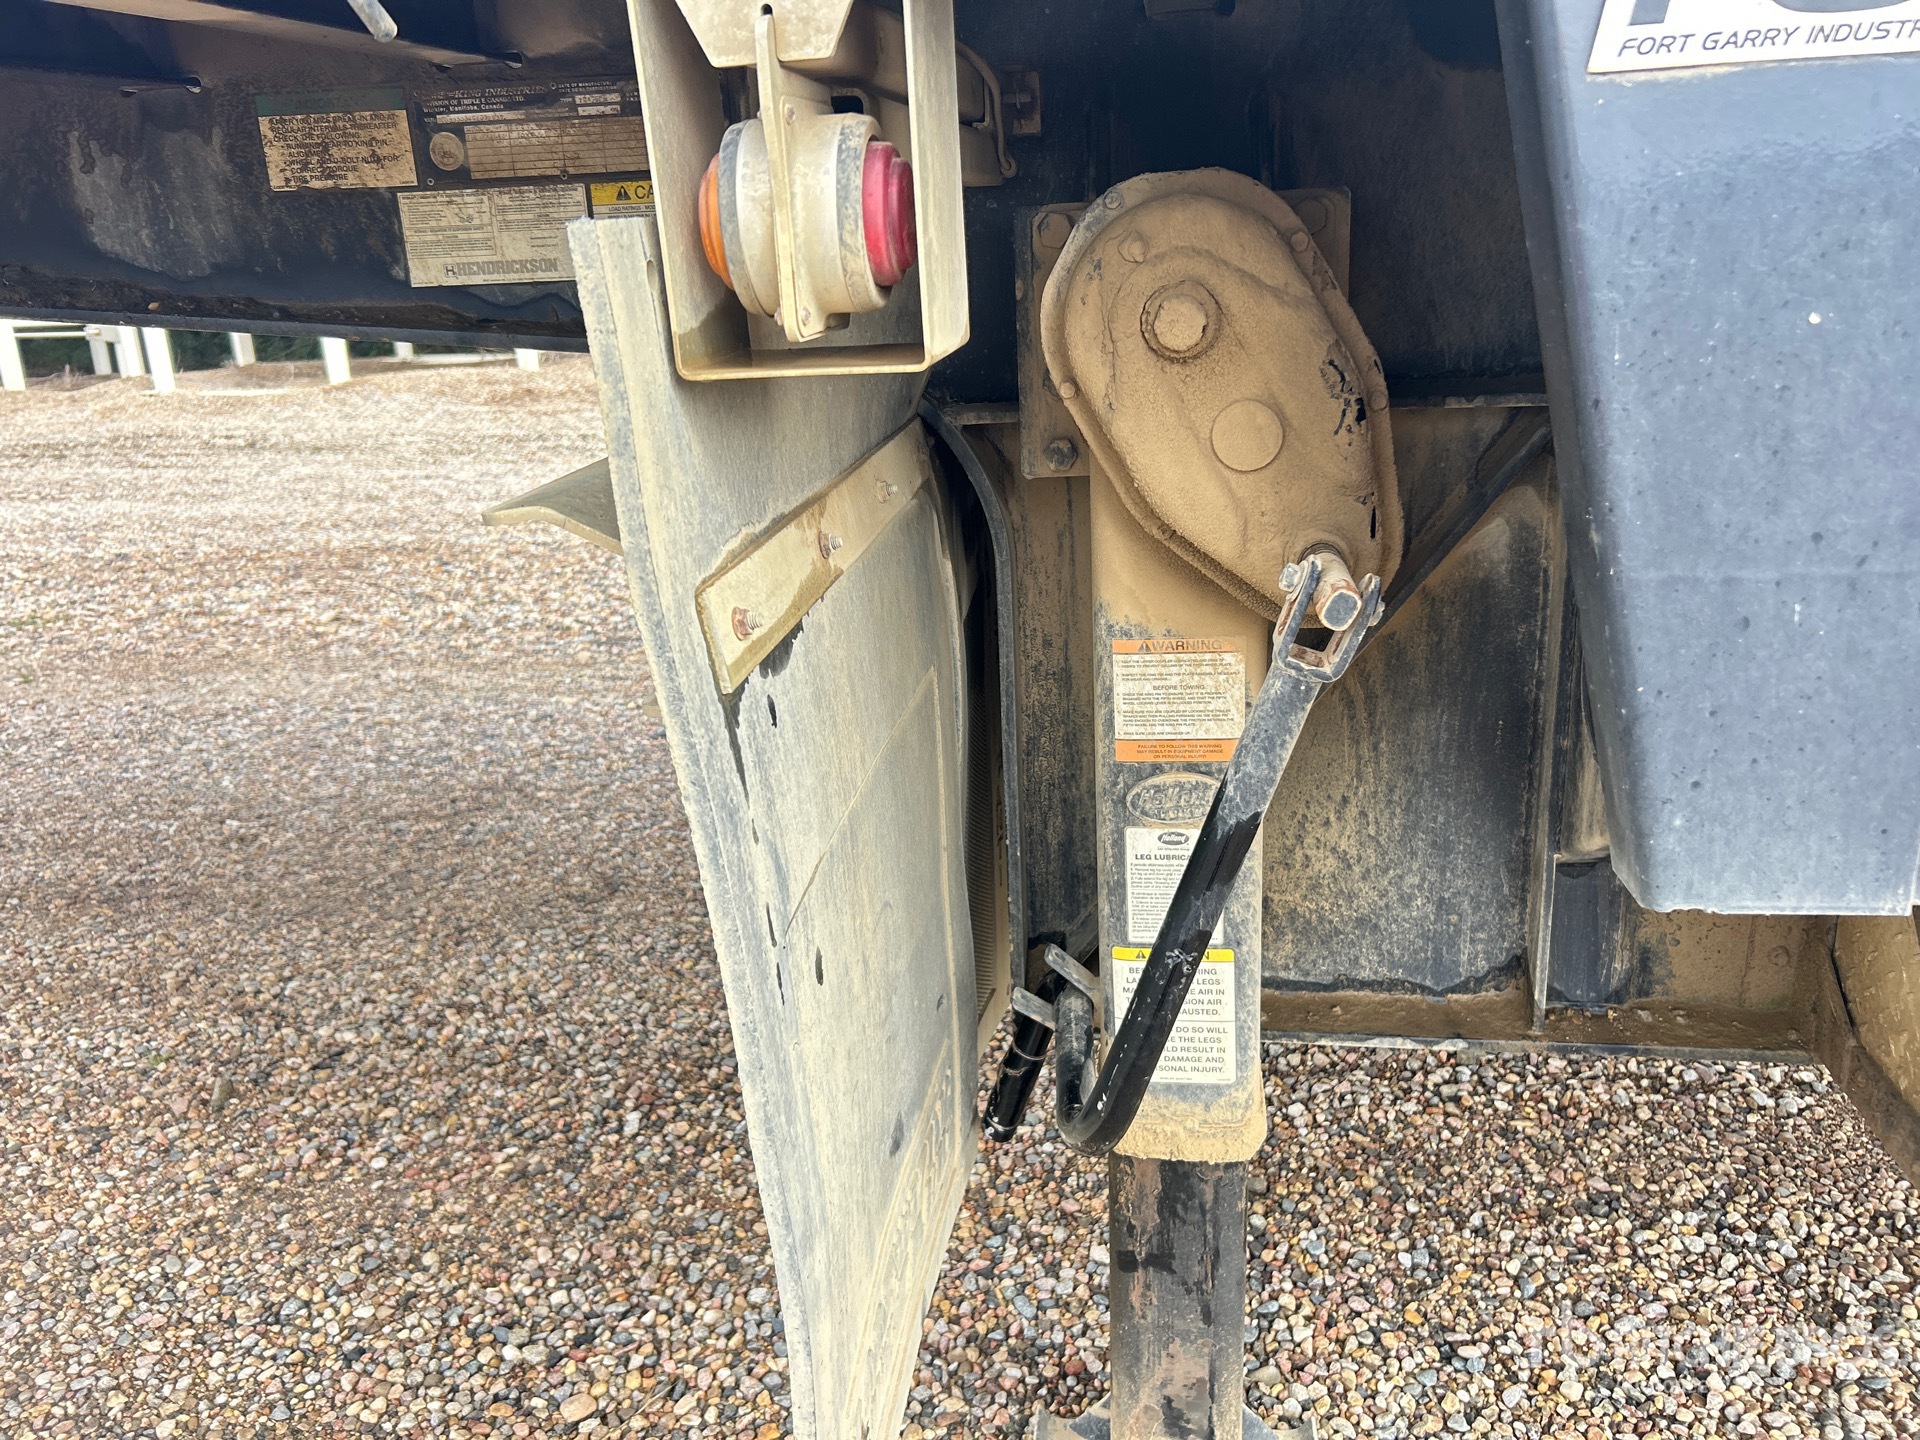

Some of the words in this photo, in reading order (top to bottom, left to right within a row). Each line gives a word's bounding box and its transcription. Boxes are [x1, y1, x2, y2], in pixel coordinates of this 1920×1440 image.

[1617, 34, 1696, 57] FORT
[1702, 26, 1800, 51] GARRY
[274, 134, 299, 142] CHECK
[456, 258, 558, 276] HENDRICKSON
[1151, 640, 1222, 650] WARNING
